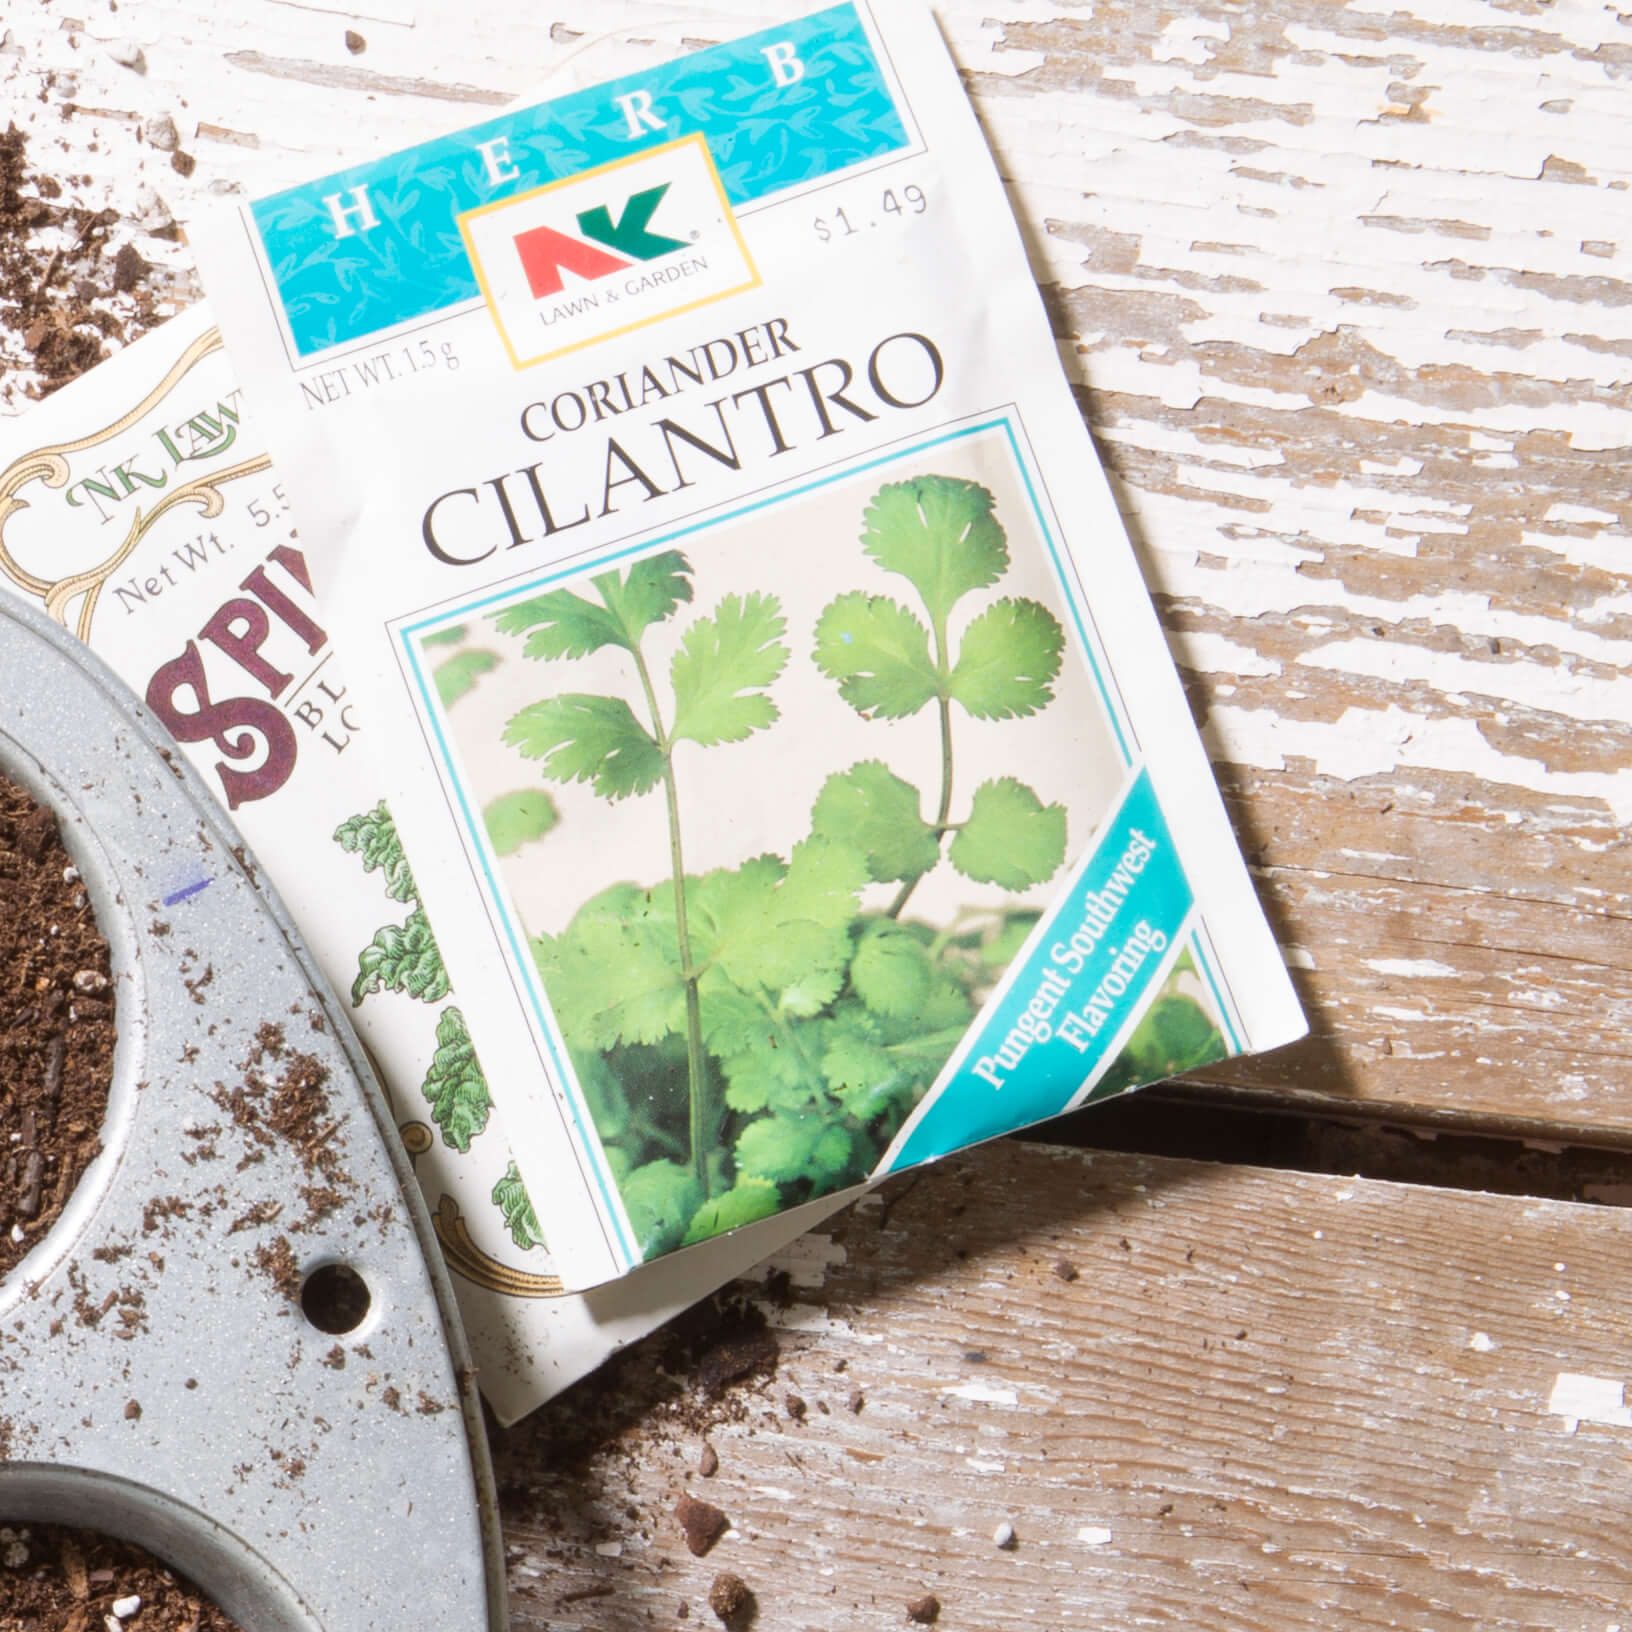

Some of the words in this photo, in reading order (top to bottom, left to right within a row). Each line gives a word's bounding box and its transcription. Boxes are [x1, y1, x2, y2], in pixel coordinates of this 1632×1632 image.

[323, 41, 806, 240] HERB
[813, 184, 929, 243] $1.49
[539, 291, 600, 327] LAWN
[605, 283, 620, 304] &
[623, 254, 709, 299] GARDEN
[299, 368, 352, 410] NET
[352, 353, 403, 388] WT.
[519, 317, 801, 442] CORIANDER
[65, 453, 168, 525] NK
[422, 331, 944, 566] CILANTRO
[113, 567, 174, 614] Net
[173, 531, 235, 572] Wt.
[972, 966, 1069, 1090] Pungent
[1049, 826, 1156, 975] Southwest
[1058, 921, 1166, 1053] Flavoring
